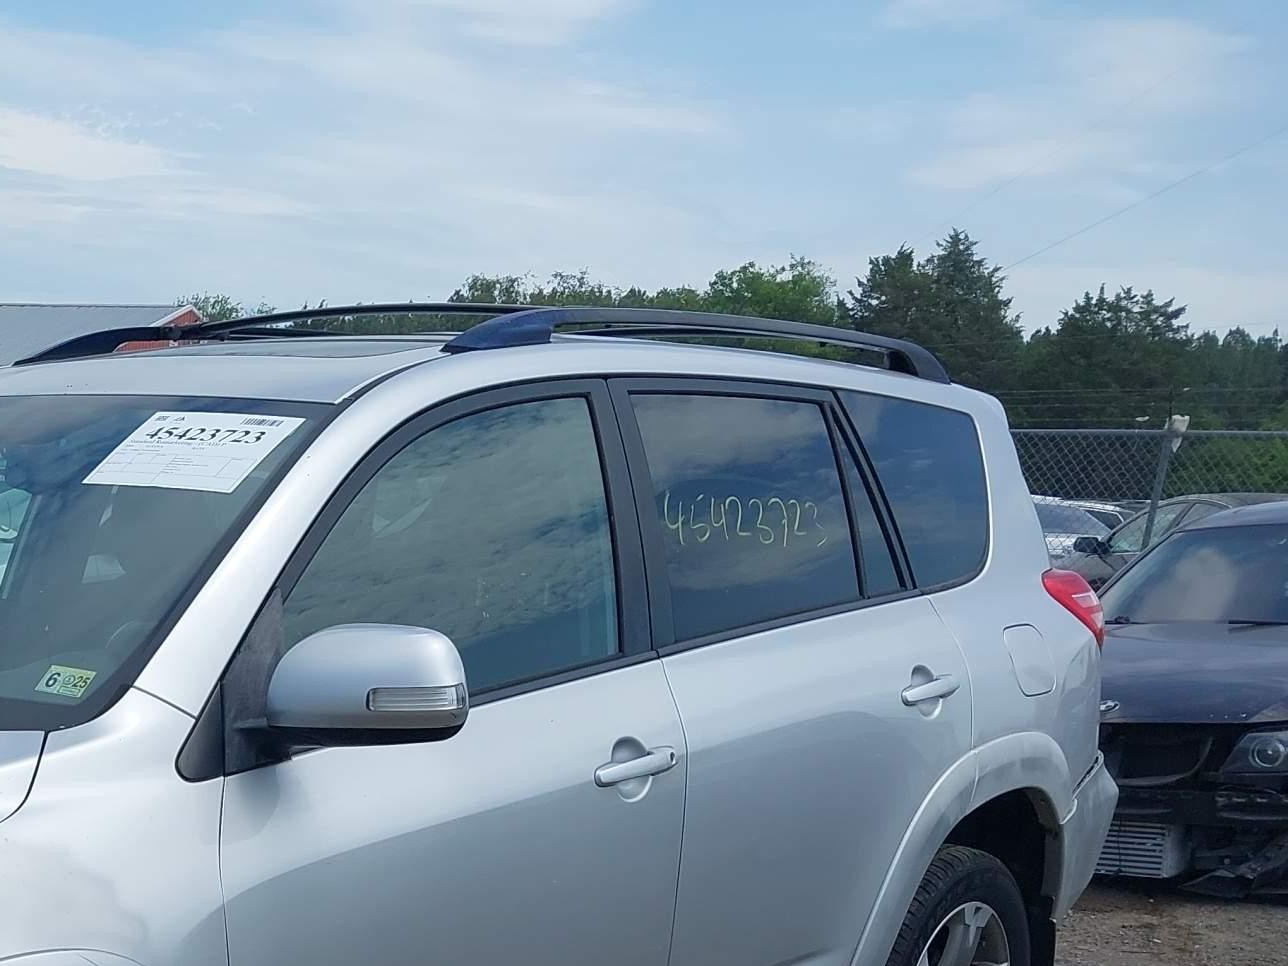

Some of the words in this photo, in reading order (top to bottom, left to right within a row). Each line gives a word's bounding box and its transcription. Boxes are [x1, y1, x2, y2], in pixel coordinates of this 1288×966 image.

[145, 426, 266, 444] 45423723
[45, 672, 61, 688] 6
[72, 675, 91, 689] 25
